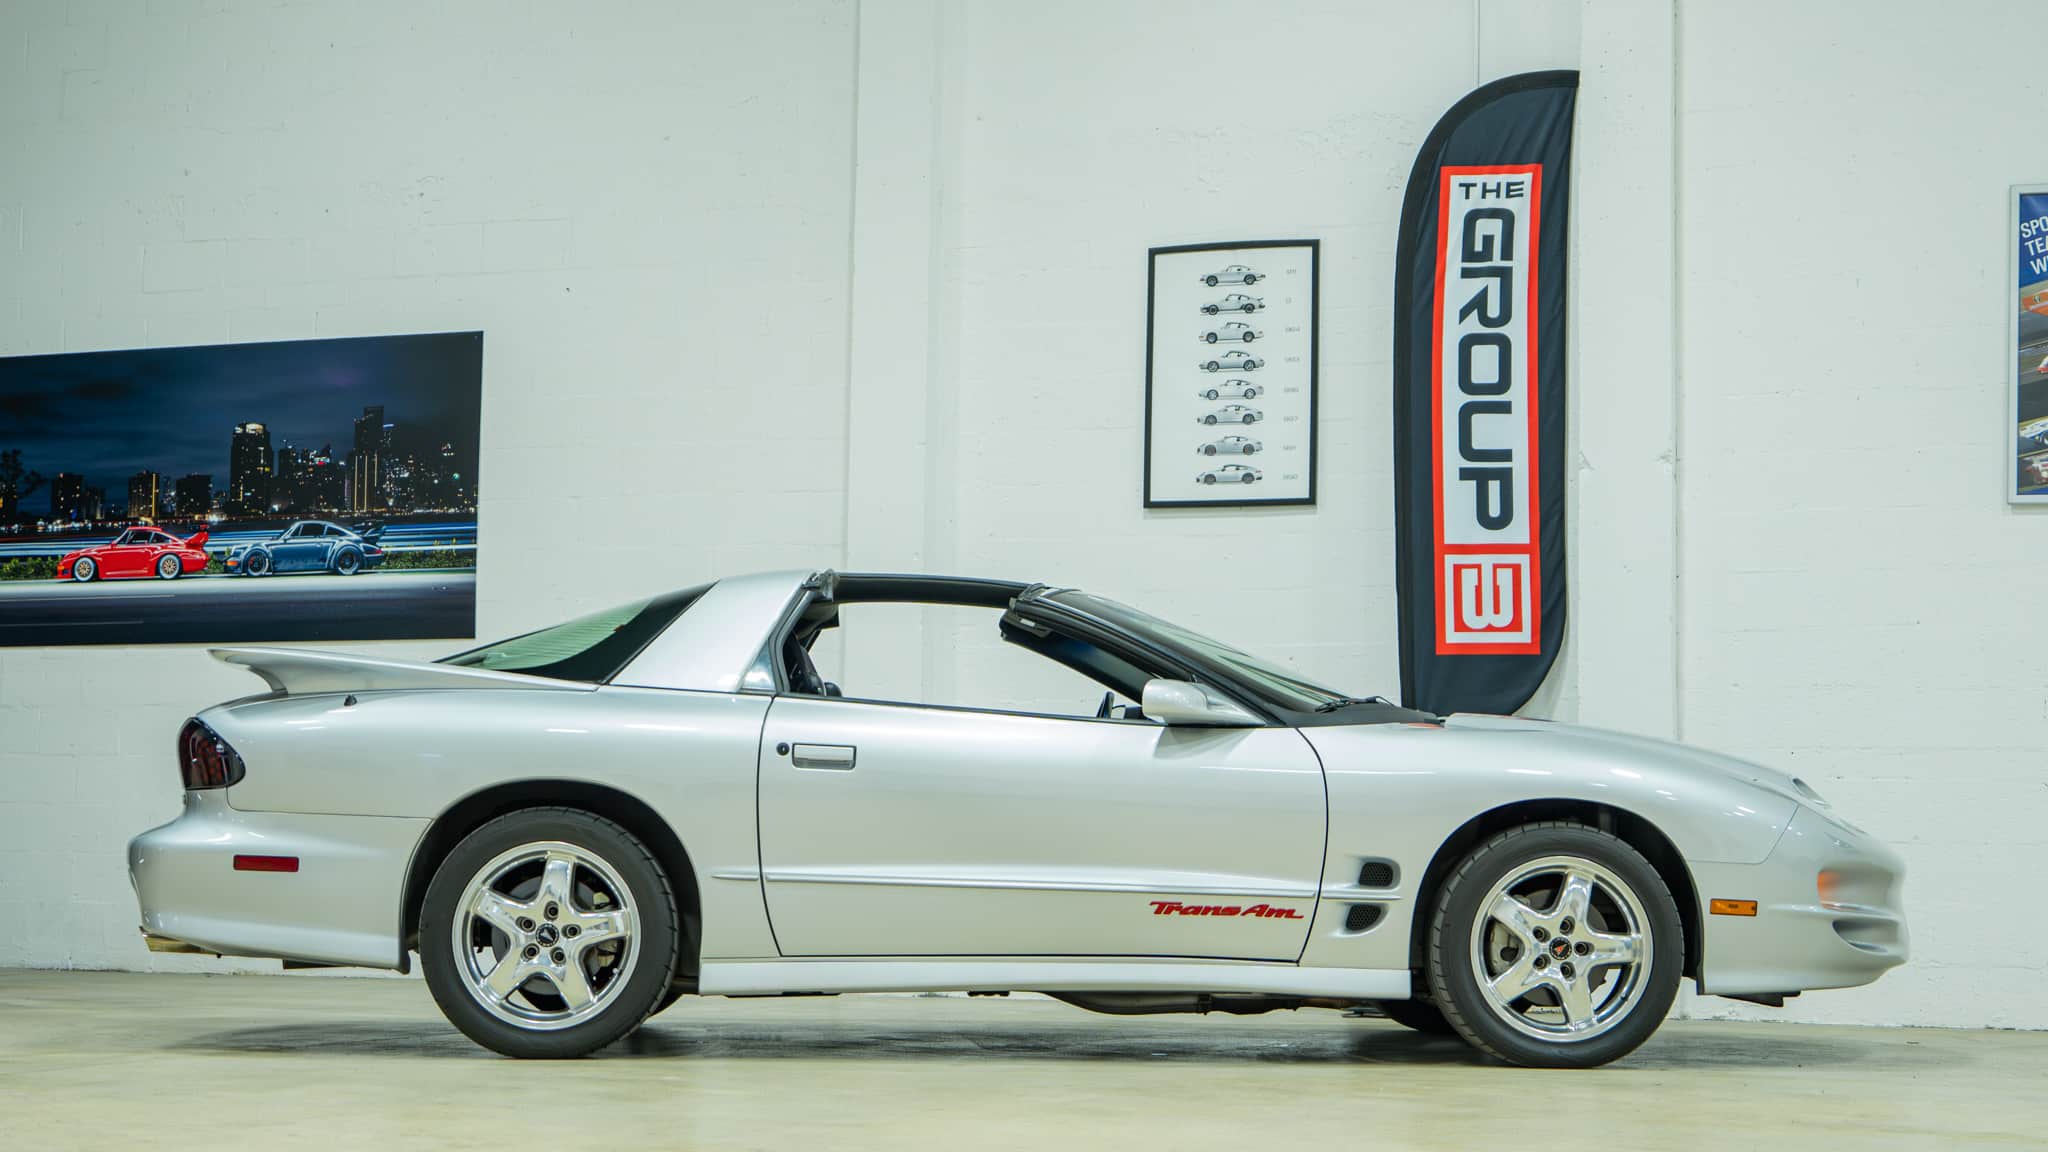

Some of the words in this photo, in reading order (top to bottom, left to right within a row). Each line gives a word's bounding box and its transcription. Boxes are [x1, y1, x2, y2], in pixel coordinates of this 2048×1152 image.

[1458, 181, 1525, 199] THE
[2024, 235, 2048, 256] TE
[1458, 207, 1515, 530] GROUP
[1149, 901, 1242, 916] Trans
[1240, 904, 1304, 919] Am
